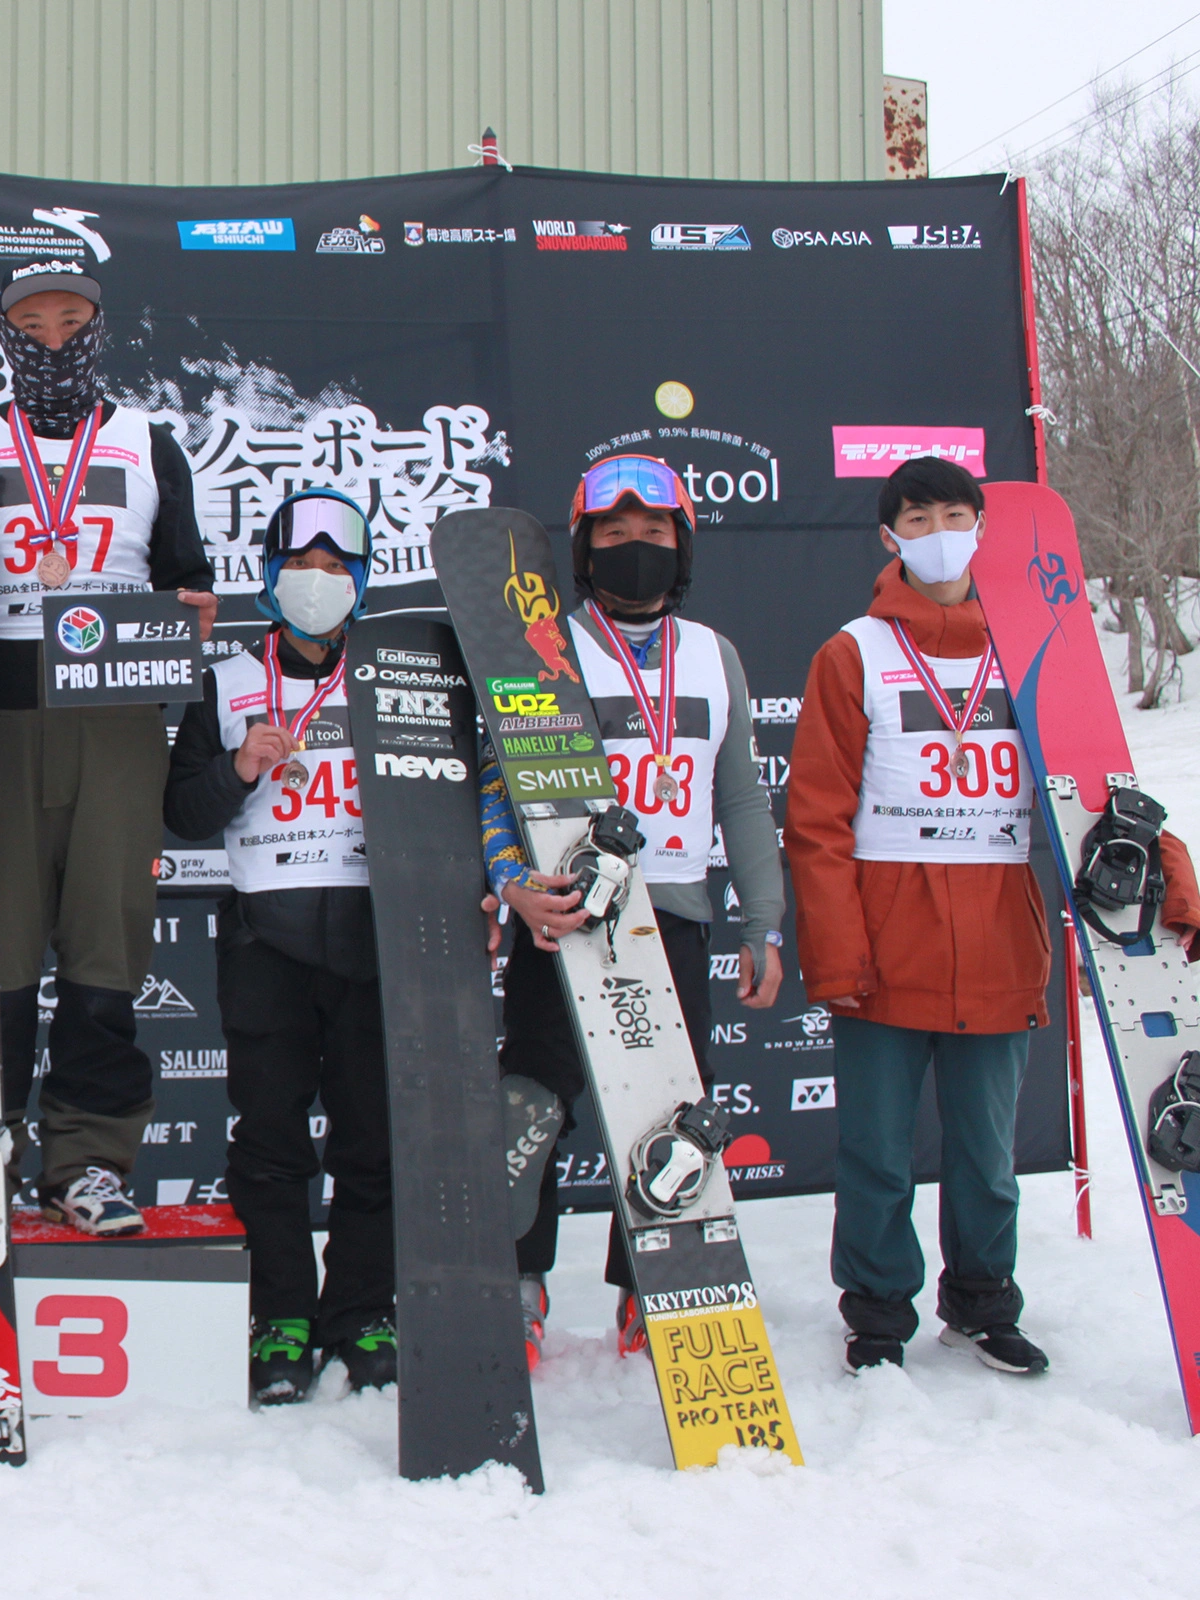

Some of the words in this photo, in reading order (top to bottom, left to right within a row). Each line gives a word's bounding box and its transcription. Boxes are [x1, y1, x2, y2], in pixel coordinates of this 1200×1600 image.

[19, 227, 54, 236] JAPAN
[191, 220, 284, 235] 石打丸山
[532, 220, 577, 237] WORLD
[911, 225, 982, 243] JSBA
[213, 234, 265, 245] ISHIUCHI
[535, 235, 629, 251] SNOWBOARDING
[794, 230, 828, 246] PSA
[830, 231, 872, 246] ASIA
[610, 429, 652, 448] 天然由来
[658, 426, 689, 439] 99.9%
[689, 427, 721, 442] 長時間
[684, 457, 779, 503] tool
[134, 621, 191, 639] JSBA
[379, 650, 439, 665] follows
[54, 663, 99, 690] PRO
[104, 659, 194, 688] LICENCE
[379, 669, 468, 687] OGASAKA
[503, 682, 536, 690] GALLIUM
[375, 687, 451, 718] FNX
[492, 693, 560, 717] UPZ
[499, 713, 583, 732] ALBERTA
[316, 728, 344, 742] tool
[502, 734, 571, 755] HANELU'Z
[375, 752, 468, 783] neve
[919, 740, 1021, 799] 309
[516, 766, 603, 792] SMITH
[270, 758, 364, 824] 345
[931, 827, 976, 840] JSBA
[181, 857, 206, 872] gray
[287, 851, 329, 865] JSBA
[745, 1165, 785, 1181] RISES
[648, 1313, 678, 1323] TUNING
[679, 1303, 731, 1319] LABORATORY
[32, 1293, 129, 1398] 3
[663, 1317, 759, 1363] FULL
[666, 1354, 775, 1405] RACE
[676, 1406, 719, 1429] PRO
[721, 1397, 780, 1422] TEAM
[734, 1419, 785, 1451] 185
